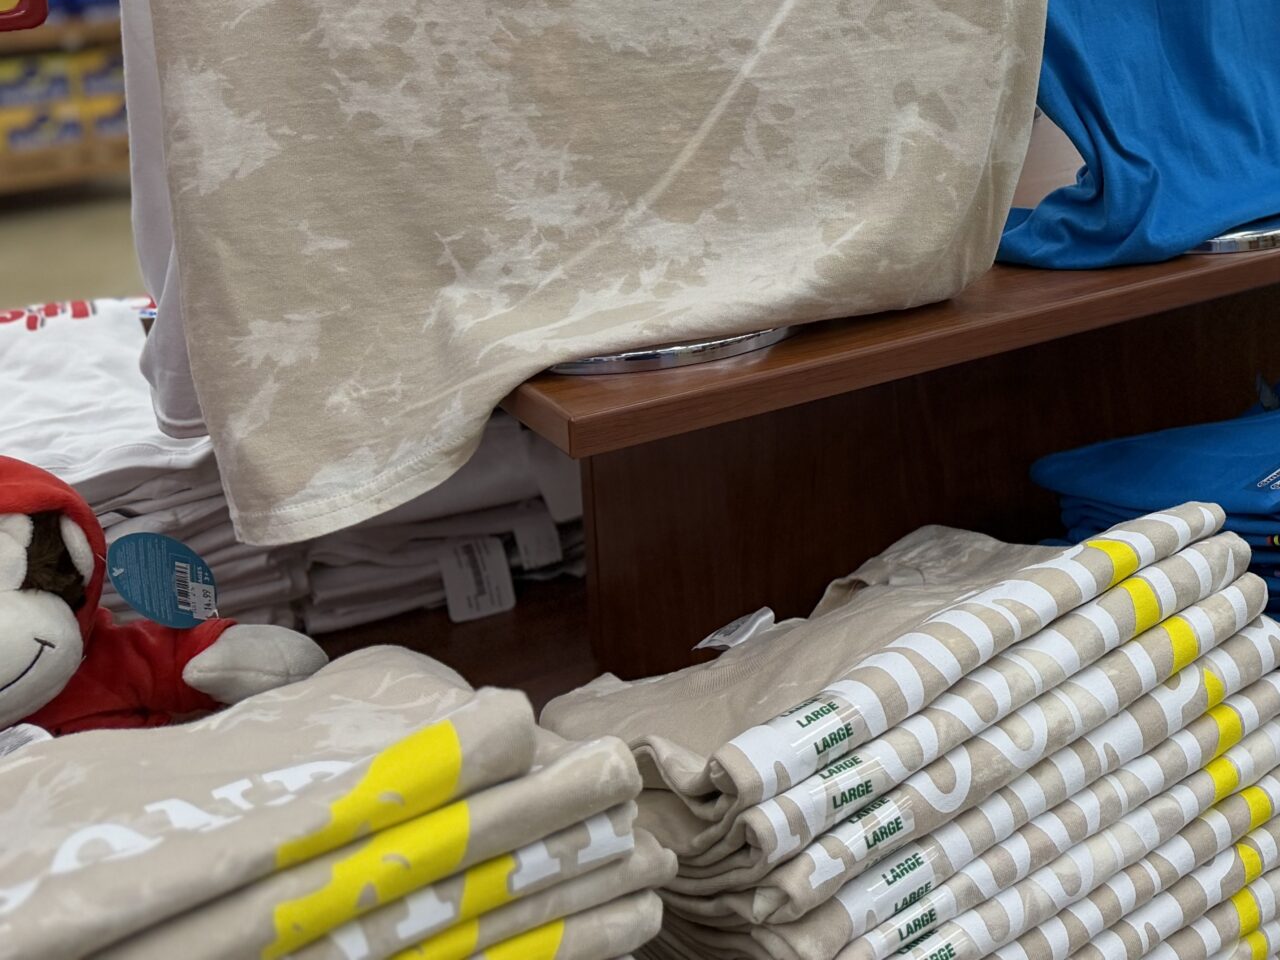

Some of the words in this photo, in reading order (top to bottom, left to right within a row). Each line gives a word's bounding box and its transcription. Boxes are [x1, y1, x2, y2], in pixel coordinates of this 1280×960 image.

[796, 700, 840, 728] LARGE
[813, 723, 854, 756] LARGE
[818, 755, 863, 780] LARGE
[832, 779, 874, 810] LARGE
[864, 816, 904, 850] LARGE
[881, 852, 925, 886] LARGE
[894, 881, 933, 914] LARGE
[897, 908, 938, 942] LARGE
